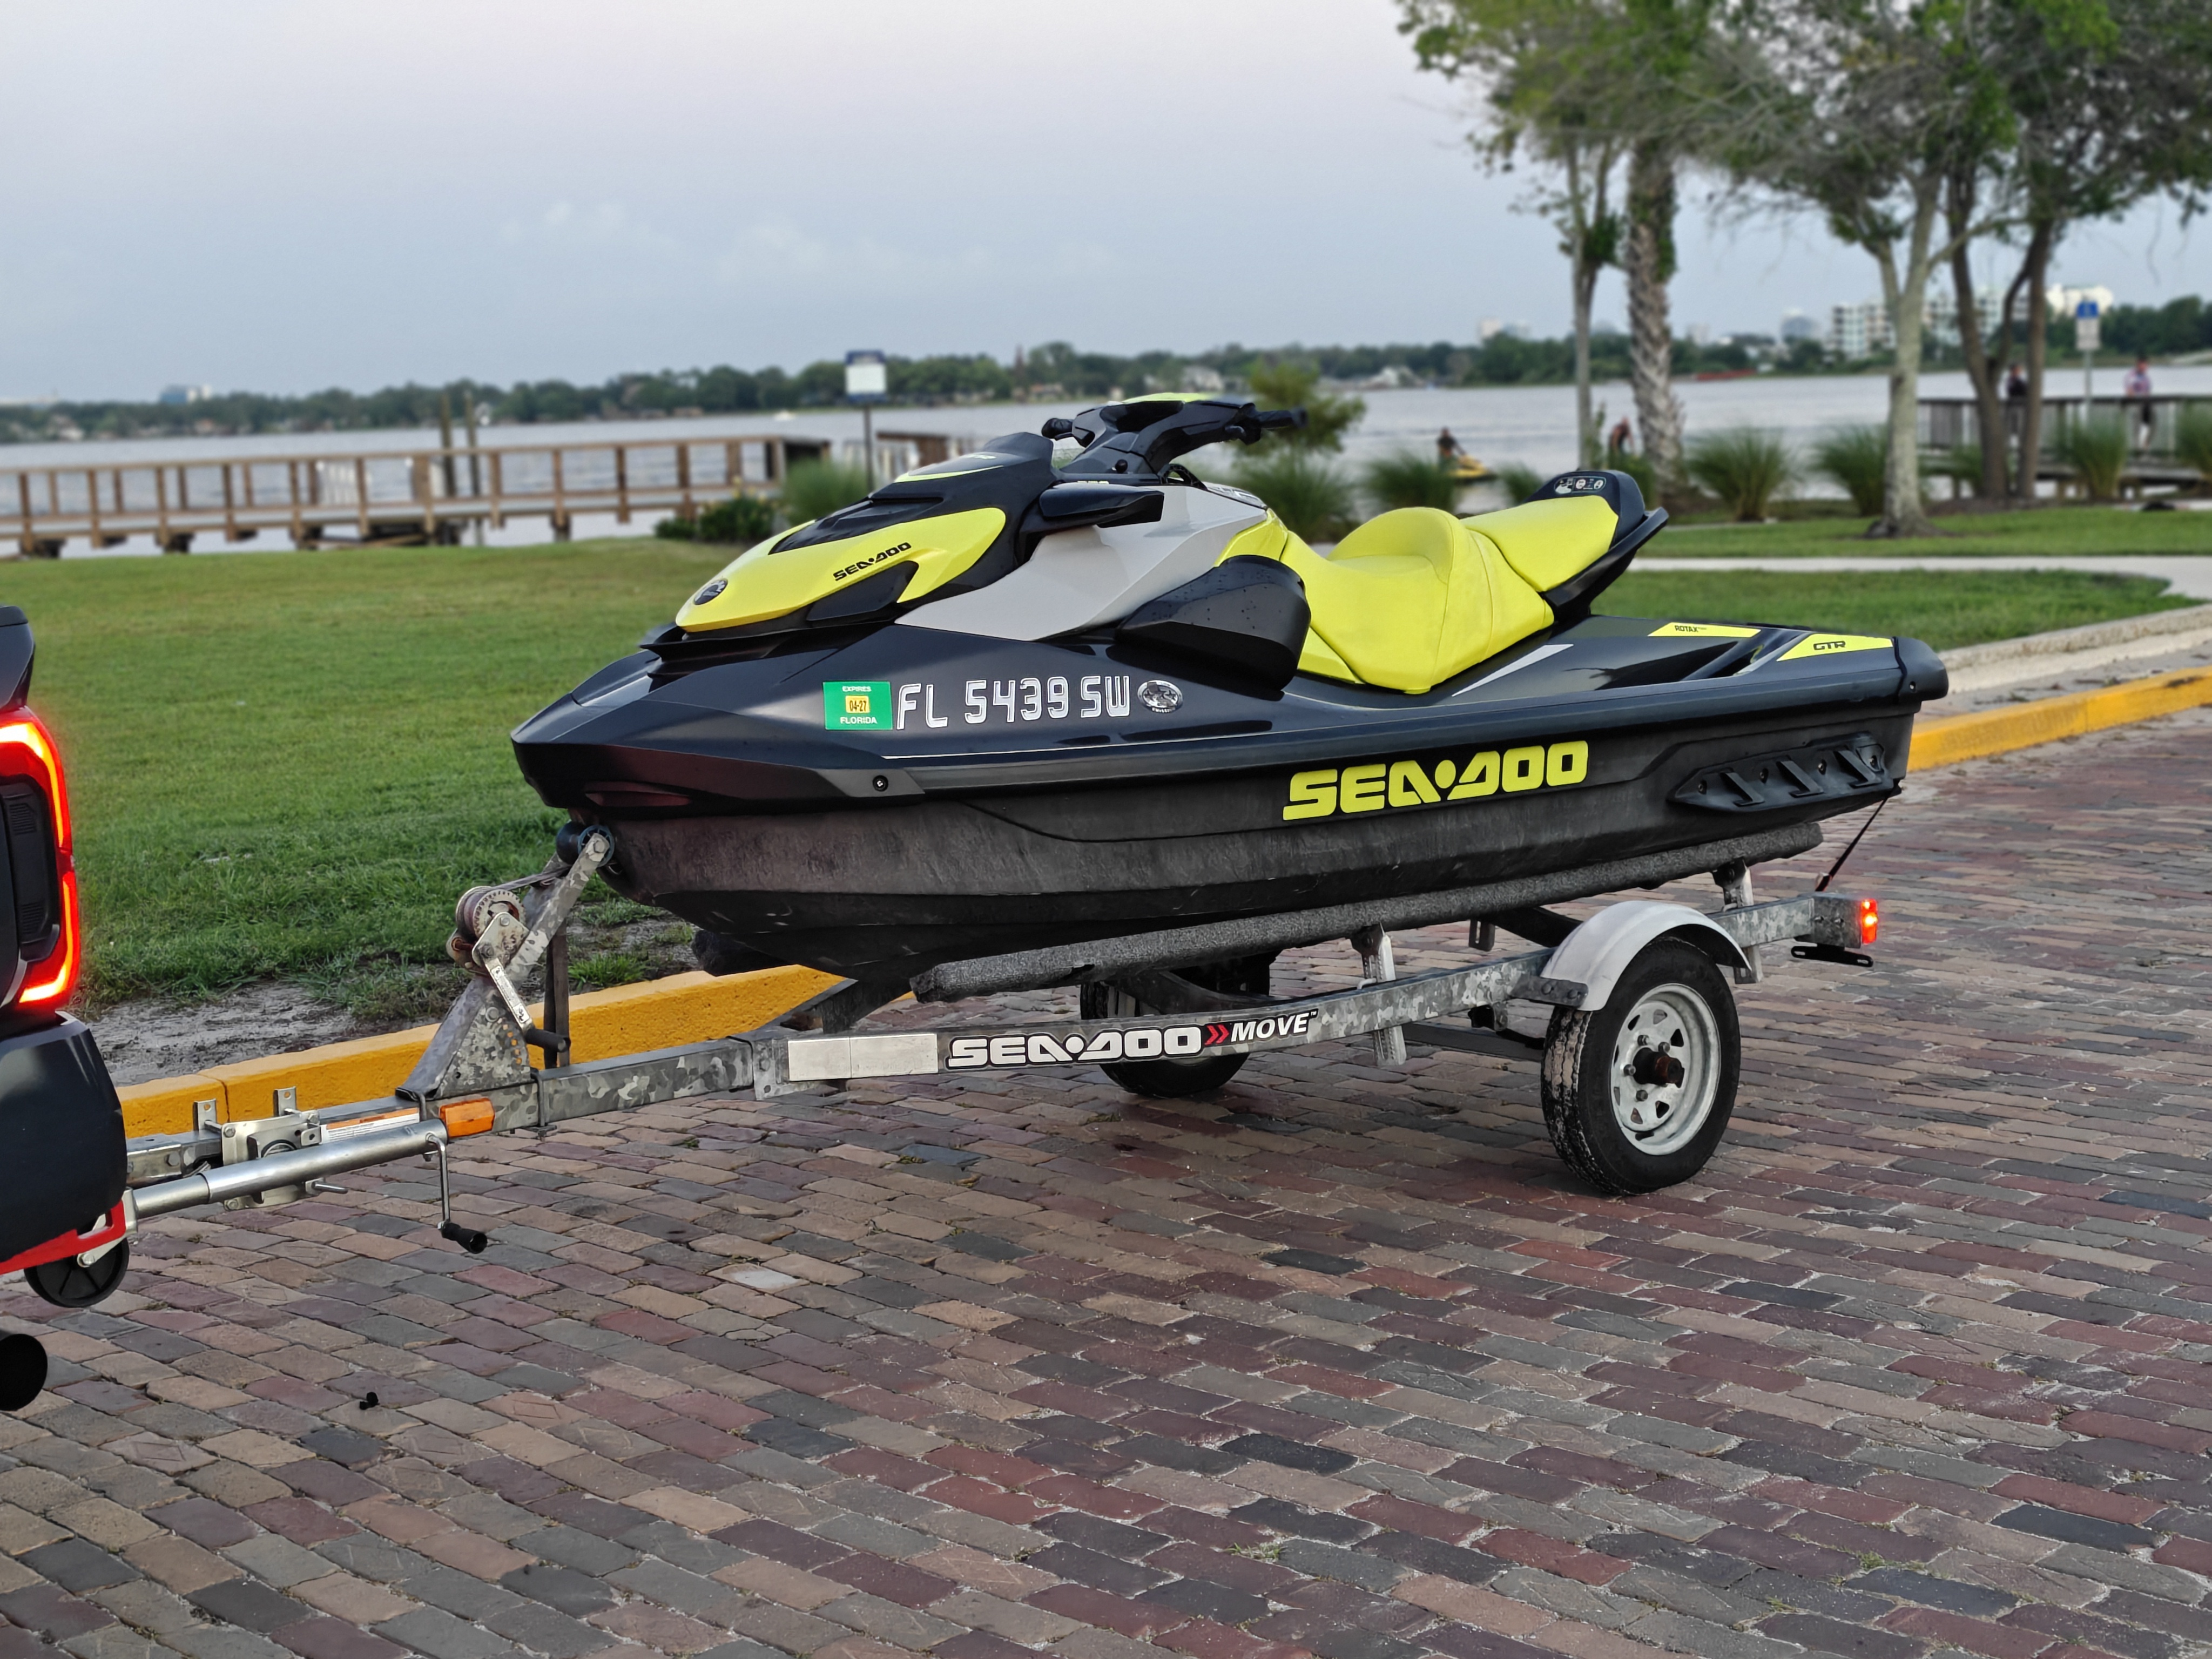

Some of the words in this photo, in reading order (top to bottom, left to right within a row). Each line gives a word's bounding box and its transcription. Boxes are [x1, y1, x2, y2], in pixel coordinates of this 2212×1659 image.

[1813, 640, 1846, 651] GTR
[849, 700, 867, 712] 04-27
[896, 683, 948, 730] FL
[965, 676, 1069, 724] 5439
[1080, 676, 1130, 718] SW
